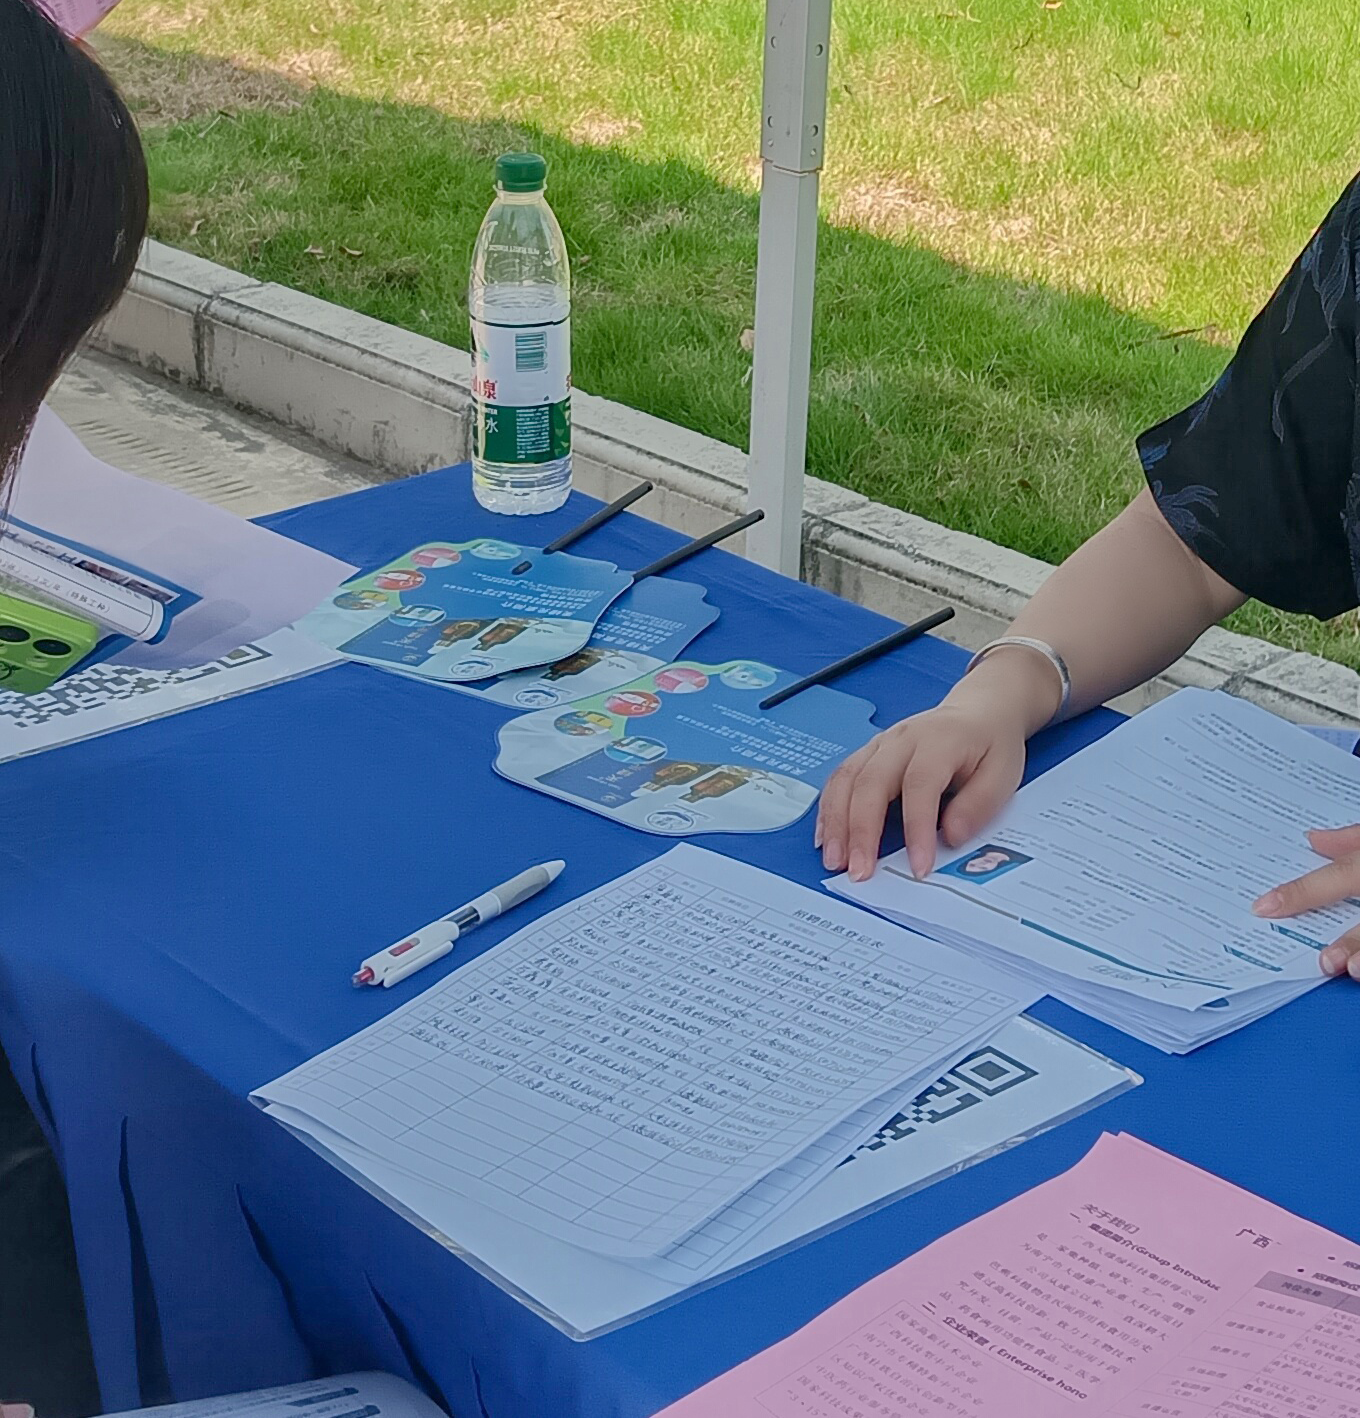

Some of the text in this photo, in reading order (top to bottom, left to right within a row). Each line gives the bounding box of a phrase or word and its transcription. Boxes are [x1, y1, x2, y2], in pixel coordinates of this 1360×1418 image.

[1081, 1201, 1139, 1235] 关于我们
[1235, 1227, 1273, 1250] 广西
